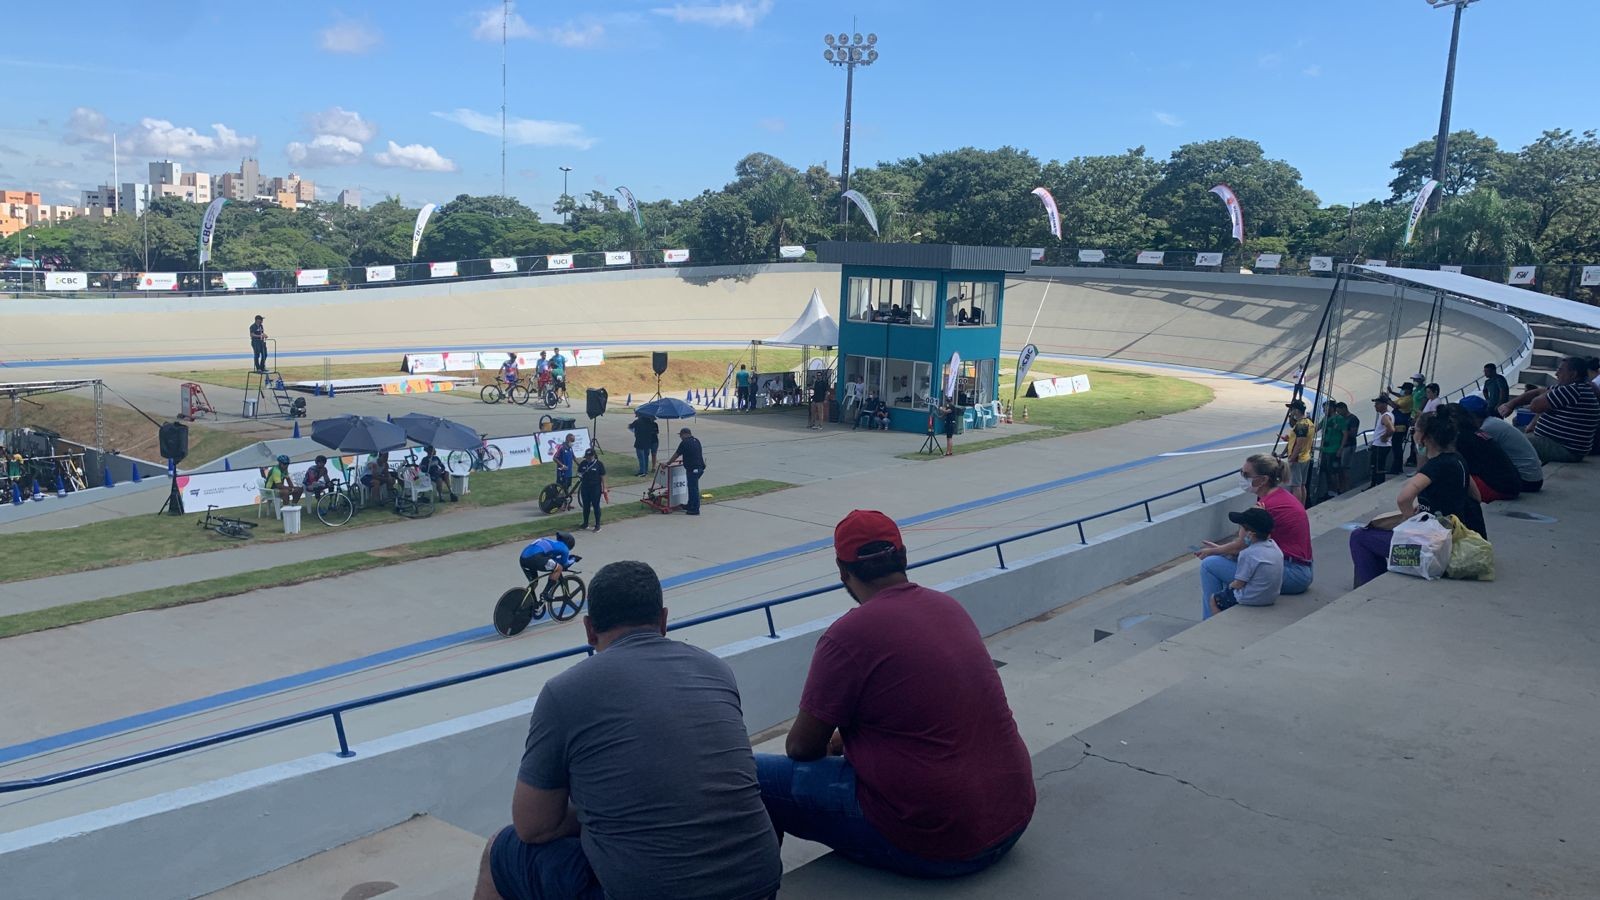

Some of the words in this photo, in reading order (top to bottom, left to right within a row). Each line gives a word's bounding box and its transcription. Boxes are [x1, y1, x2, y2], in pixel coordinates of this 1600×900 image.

[202, 222, 213, 244] CBC
[414, 223, 423, 242] CBC
[1021, 348, 1034, 366] CBC
[1392, 546, 1417, 556] Super
